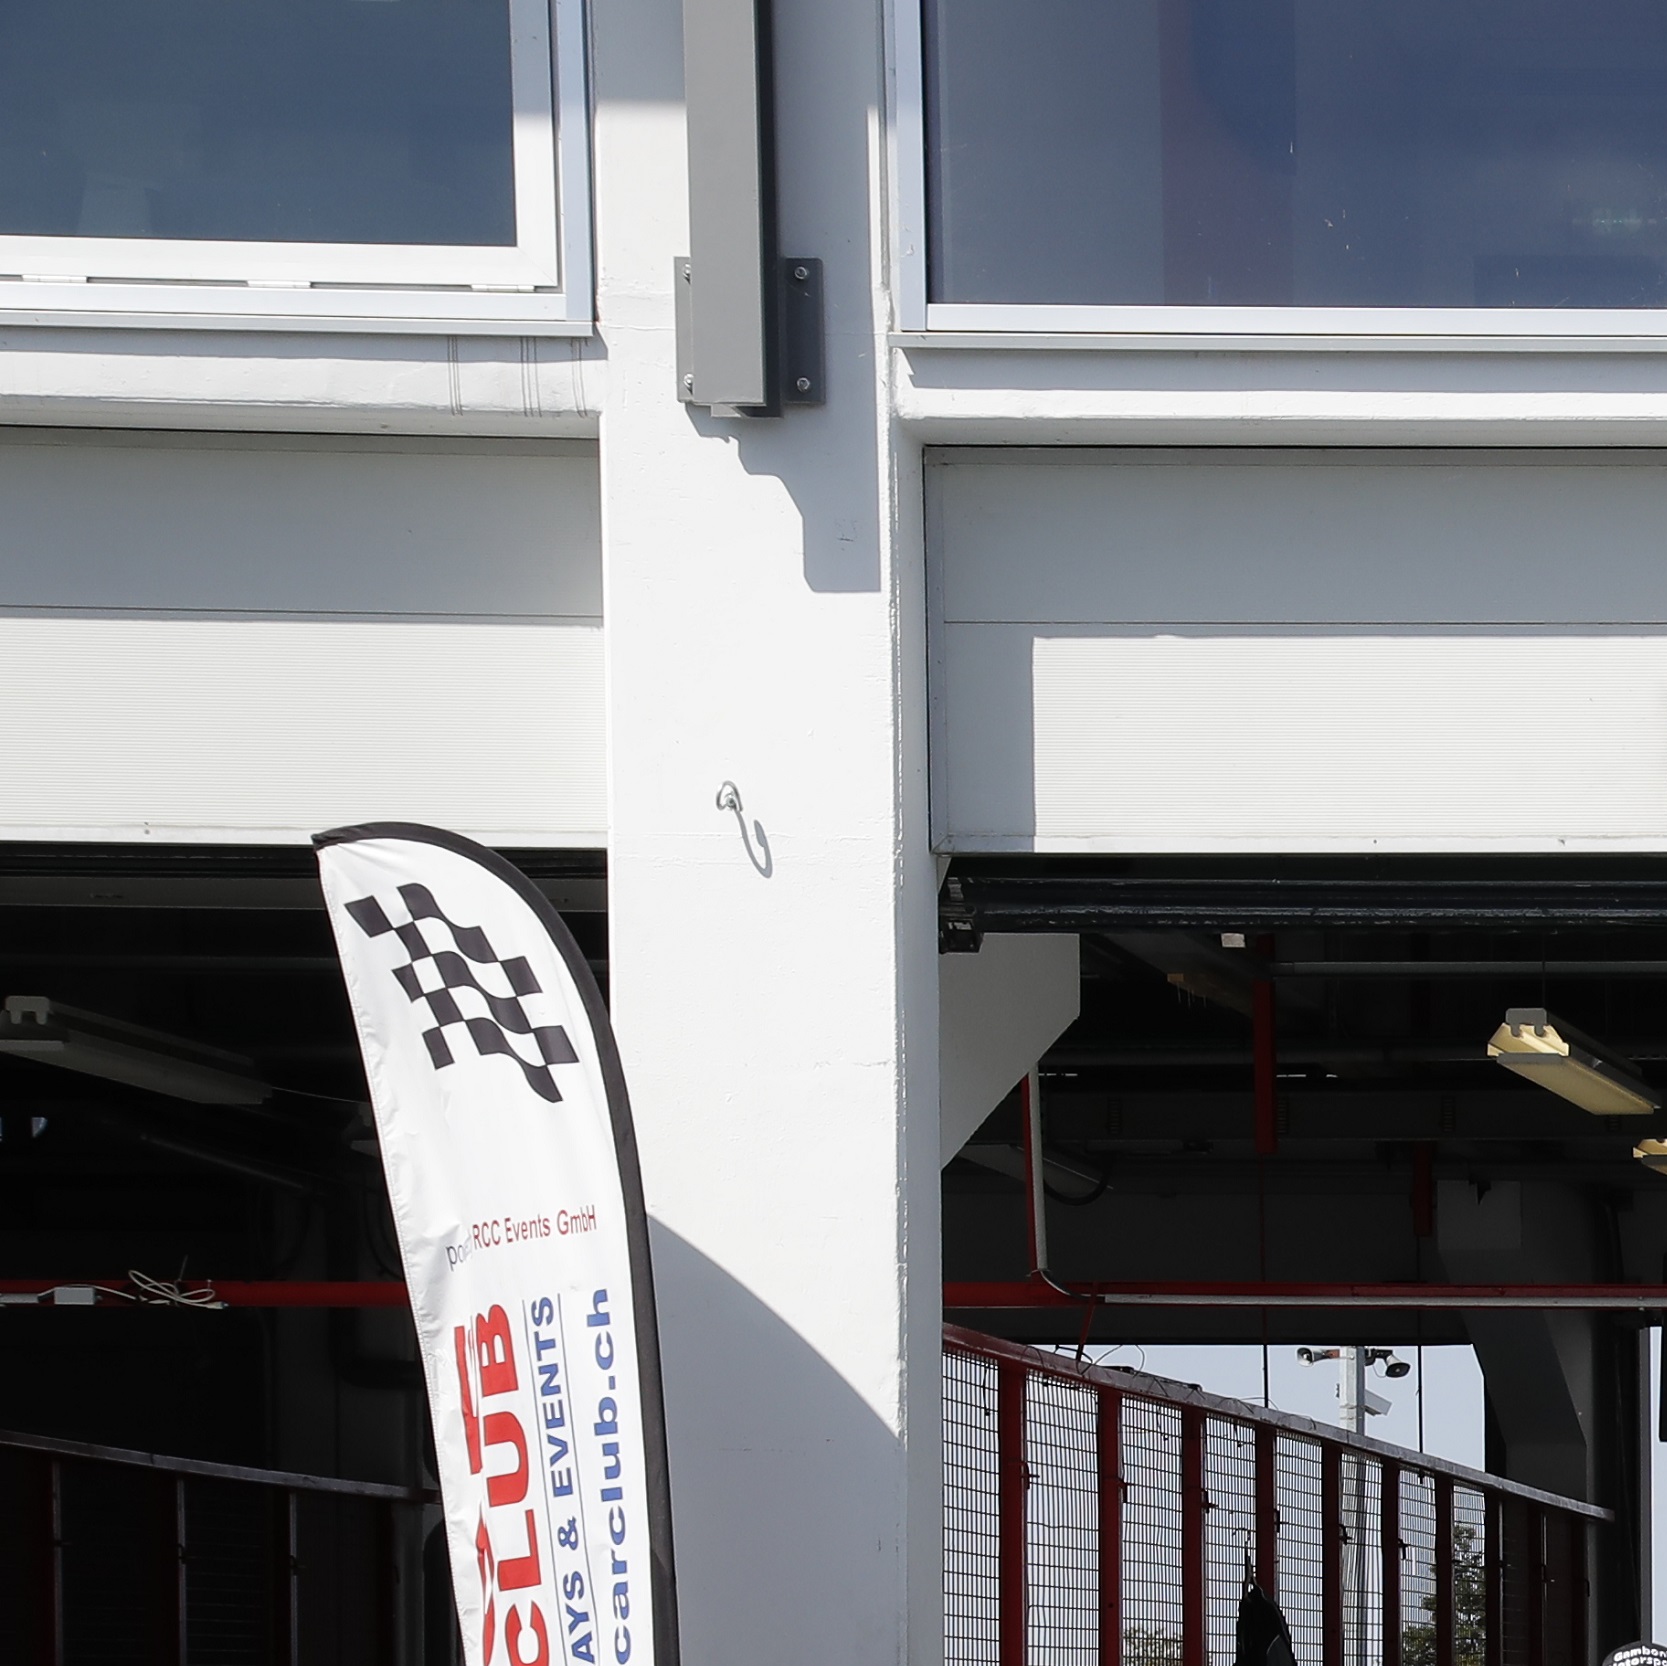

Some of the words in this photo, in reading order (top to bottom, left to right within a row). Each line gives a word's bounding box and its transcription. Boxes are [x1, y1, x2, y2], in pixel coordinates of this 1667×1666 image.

[472, 1219, 501, 1250] RCC
[504, 1213, 551, 1244] Events
[556, 1204, 597, 1235] GmbH
[531, 1296, 574, 1498] EVENTS
[558, 1516, 579, 1551] &
